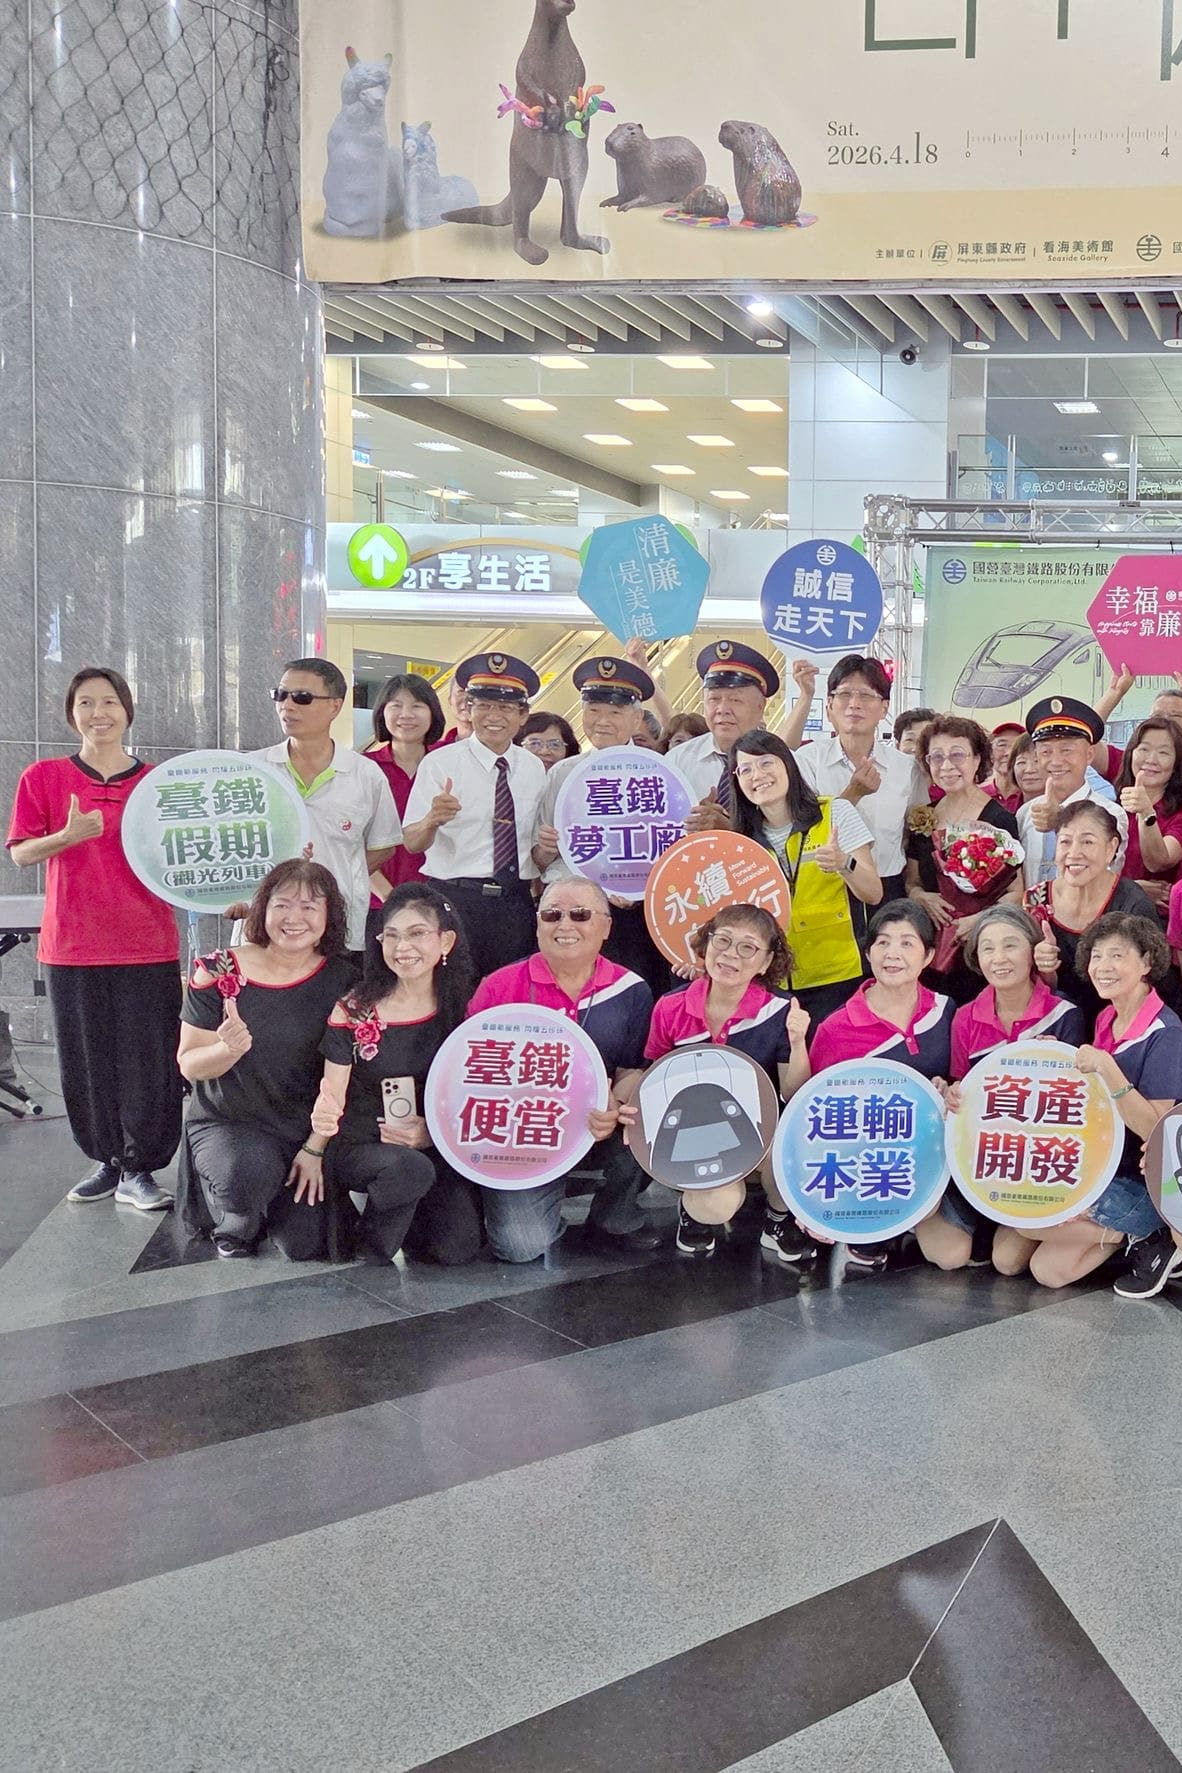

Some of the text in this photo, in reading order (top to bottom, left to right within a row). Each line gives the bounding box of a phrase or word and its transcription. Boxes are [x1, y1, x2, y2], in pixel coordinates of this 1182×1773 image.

[827, 120, 859, 137] Sat.
[827, 131, 938, 166] 2026.4.18
[1160, 147, 1170, 158] 4
[875, 248, 915, 258] 主辦單位
[957, 241, 1026, 255] 屏東縣政府
[1043, 239, 1114, 253] 看海美術館
[1048, 253, 1109, 263] Seaside Gallery
[638, 522, 682, 593] 清廉
[972, 561, 1115, 576] 國營臺灣鐵路股份有限
[617, 559, 657, 638] 是美德
[792, 567, 855, 603] 誠信
[999, 577, 1026, 585] Railway
[1105, 585, 1159, 615] 幸福
[772, 603, 867, 640] 走天下
[155, 776, 266, 822] 臺鐵
[585, 775, 666, 817] 臺鐵
[160, 819, 271, 866] 假期
[567, 823, 687, 864] 夢工廠
[664, 860, 734, 926] 永續
[463, 1038, 571, 1090] 臺鐵
[807, 1093, 914, 1142] 運輸
[980, 1073, 1087, 1126] 資產
[459, 1096, 566, 1148] 便當
[804, 1150, 912, 1200] 本業
[974, 1131, 1081, 1186] 開發
